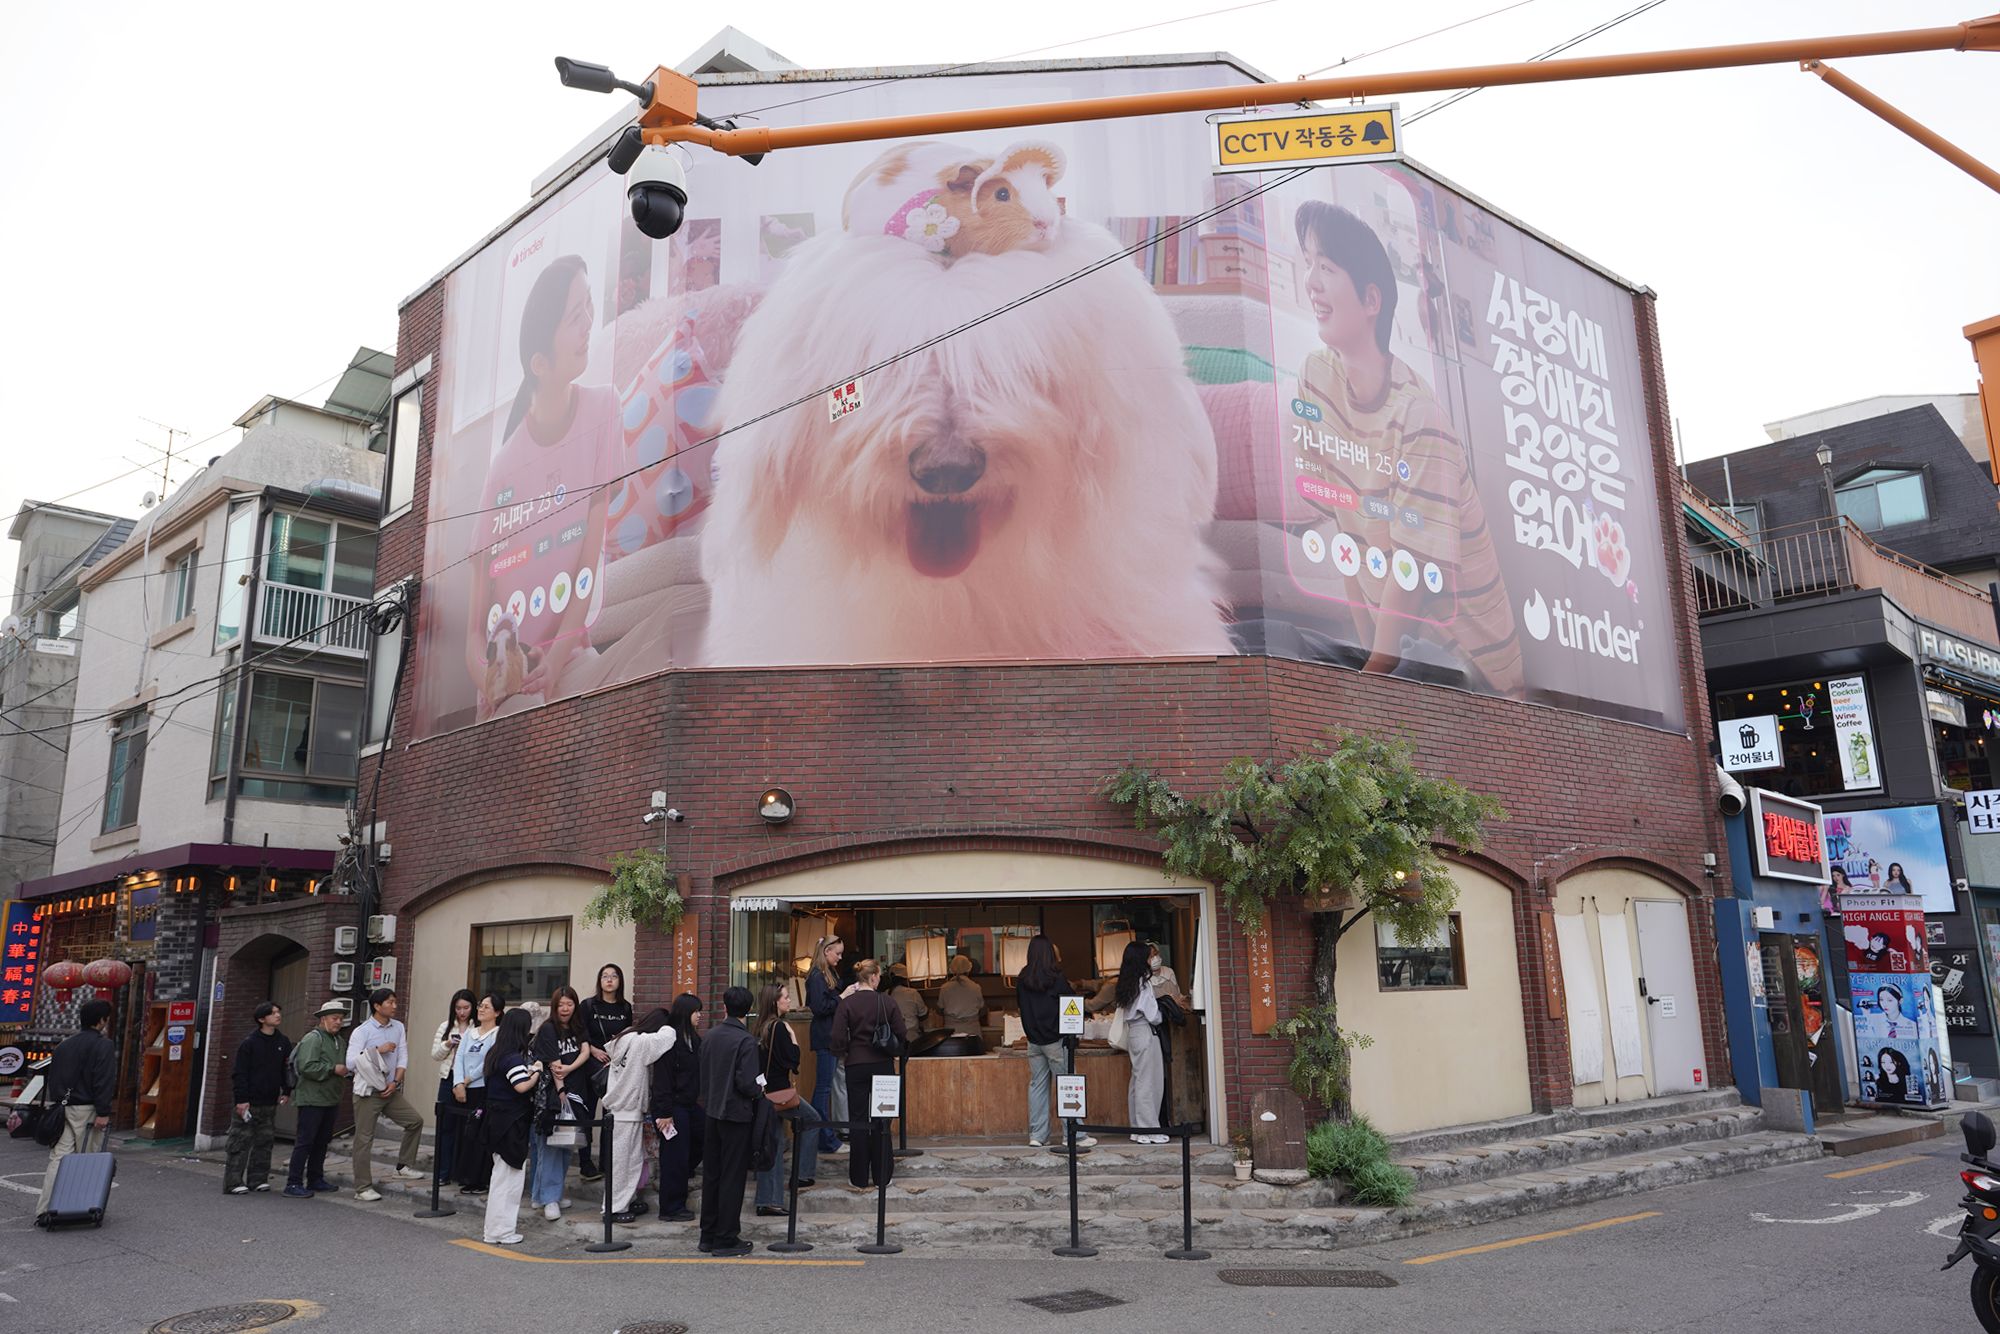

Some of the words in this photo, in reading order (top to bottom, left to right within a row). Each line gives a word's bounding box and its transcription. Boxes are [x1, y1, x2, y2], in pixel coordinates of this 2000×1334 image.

[1223, 131, 1290, 154] CCTV
[1295, 125, 1358, 148] 작동중
[519, 236, 545, 263] tinder
[1486, 270, 1609, 382] 사랑에
[1491, 334, 1619, 447] 정해진
[1292, 424, 1370, 471] 가나디러버
[1375, 453, 1393, 476] 25
[1503, 404, 1626, 511] 모양은
[537, 491, 551, 514] 23
[1508, 479, 1598, 570] 없어
[1552, 598, 1641, 665] tinder
[1831, 687, 1863, 697] Cocktail
[1834, 704, 1863, 712] Whisky
[1836, 720, 1863, 728] Coffee
[1729, 750, 1774, 766] 건어물녀
[1842, 912, 1867, 922] HIGH
[1869, 911, 1901, 921] ANGLE
[2, 921, 28, 1005] 中華福春
[1952, 954, 1969, 965] 2F
[1850, 976, 1877, 985] YEAR
[1880, 976, 1907, 985] BOOK
[1945, 1004, 1976, 1014] 주공간
